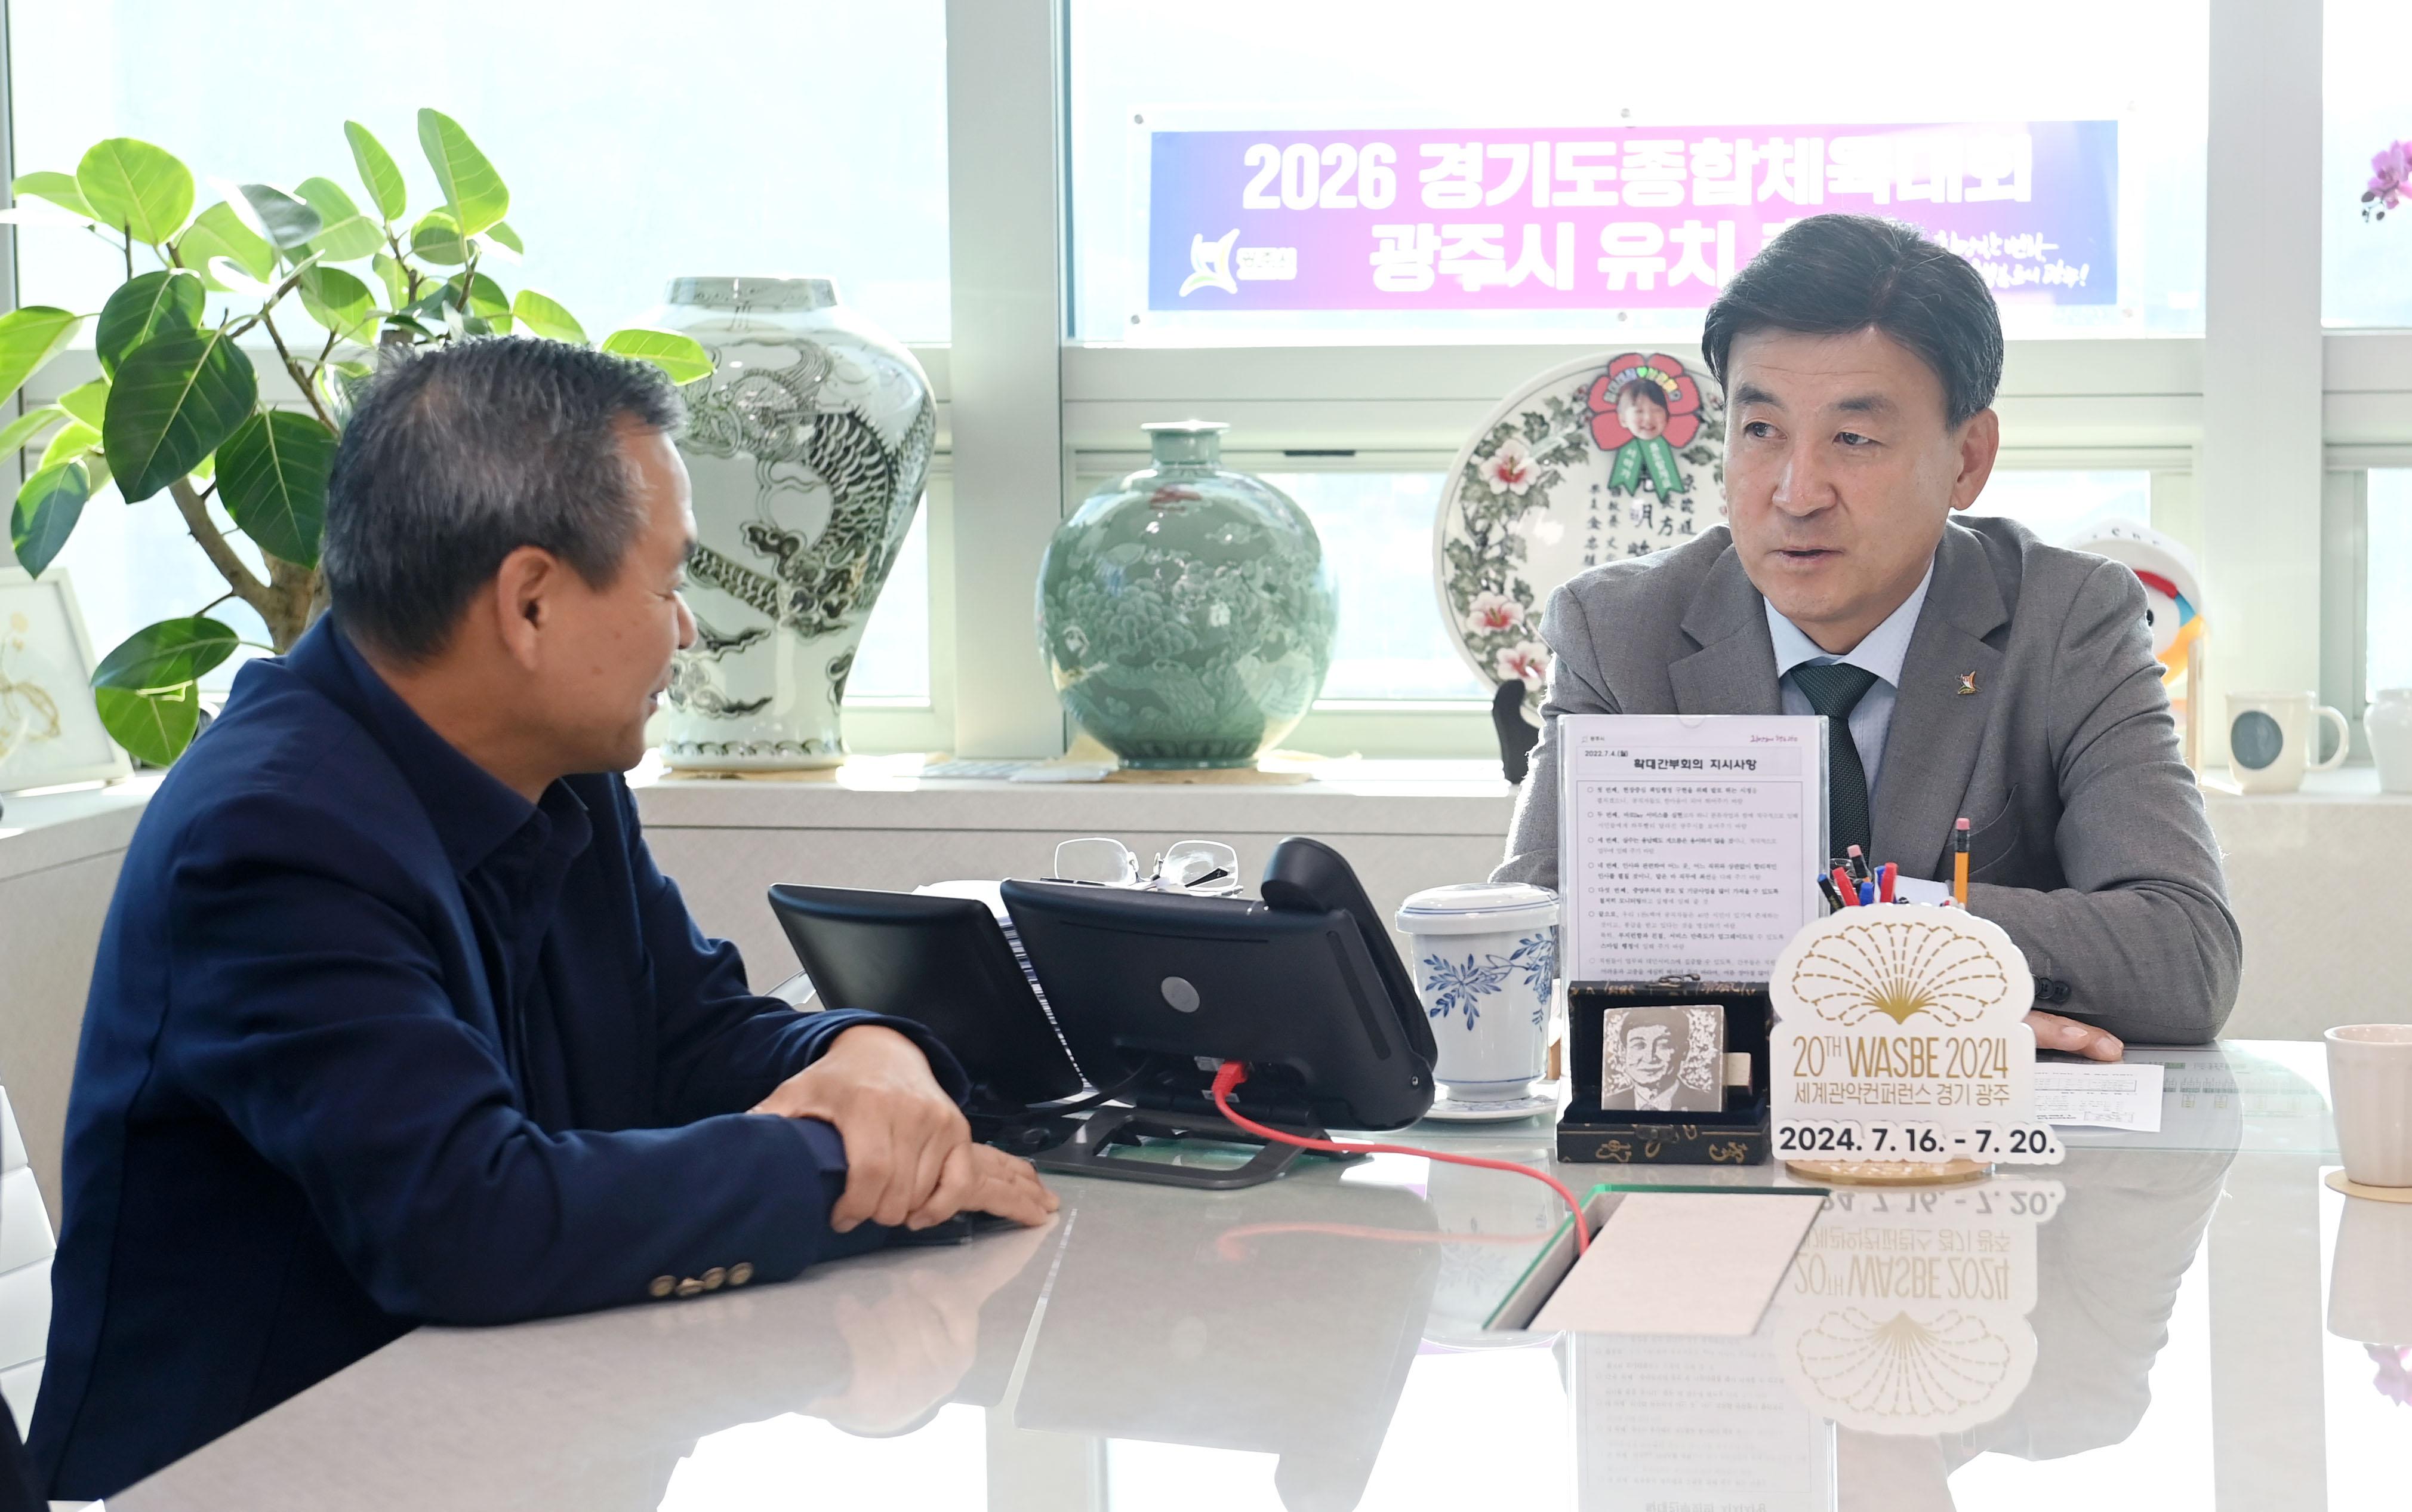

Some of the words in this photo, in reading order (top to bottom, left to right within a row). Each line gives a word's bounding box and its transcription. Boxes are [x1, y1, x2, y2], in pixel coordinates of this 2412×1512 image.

[1242, 141, 1397, 210] 2026
[1419, 134, 2032, 209] 경기도종합체육대회
[1369, 221, 1575, 293] 광주시
[1597, 221, 1735, 292] 유치
[1633, 759, 1703, 770] 확대간부회의
[1710, 759, 1757, 771] 지시사항
[1846, 1036, 1939, 1079] WASBE
[1945, 1037, 2009, 1079] 2024
[1794, 1082, 1932, 1105] 세계관악컨퍼런스
[1936, 1083, 1970, 1106] 경기
[1976, 1084, 2010, 1106] 광주
[1779, 1126, 1862, 1151] 2024.
[1872, 1128, 1896, 1151] 7.
[1905, 1128, 1945, 1152] 16.
[1975, 1129, 2000, 1153] 7.
[2010, 1130, 2055, 1154] 20.
